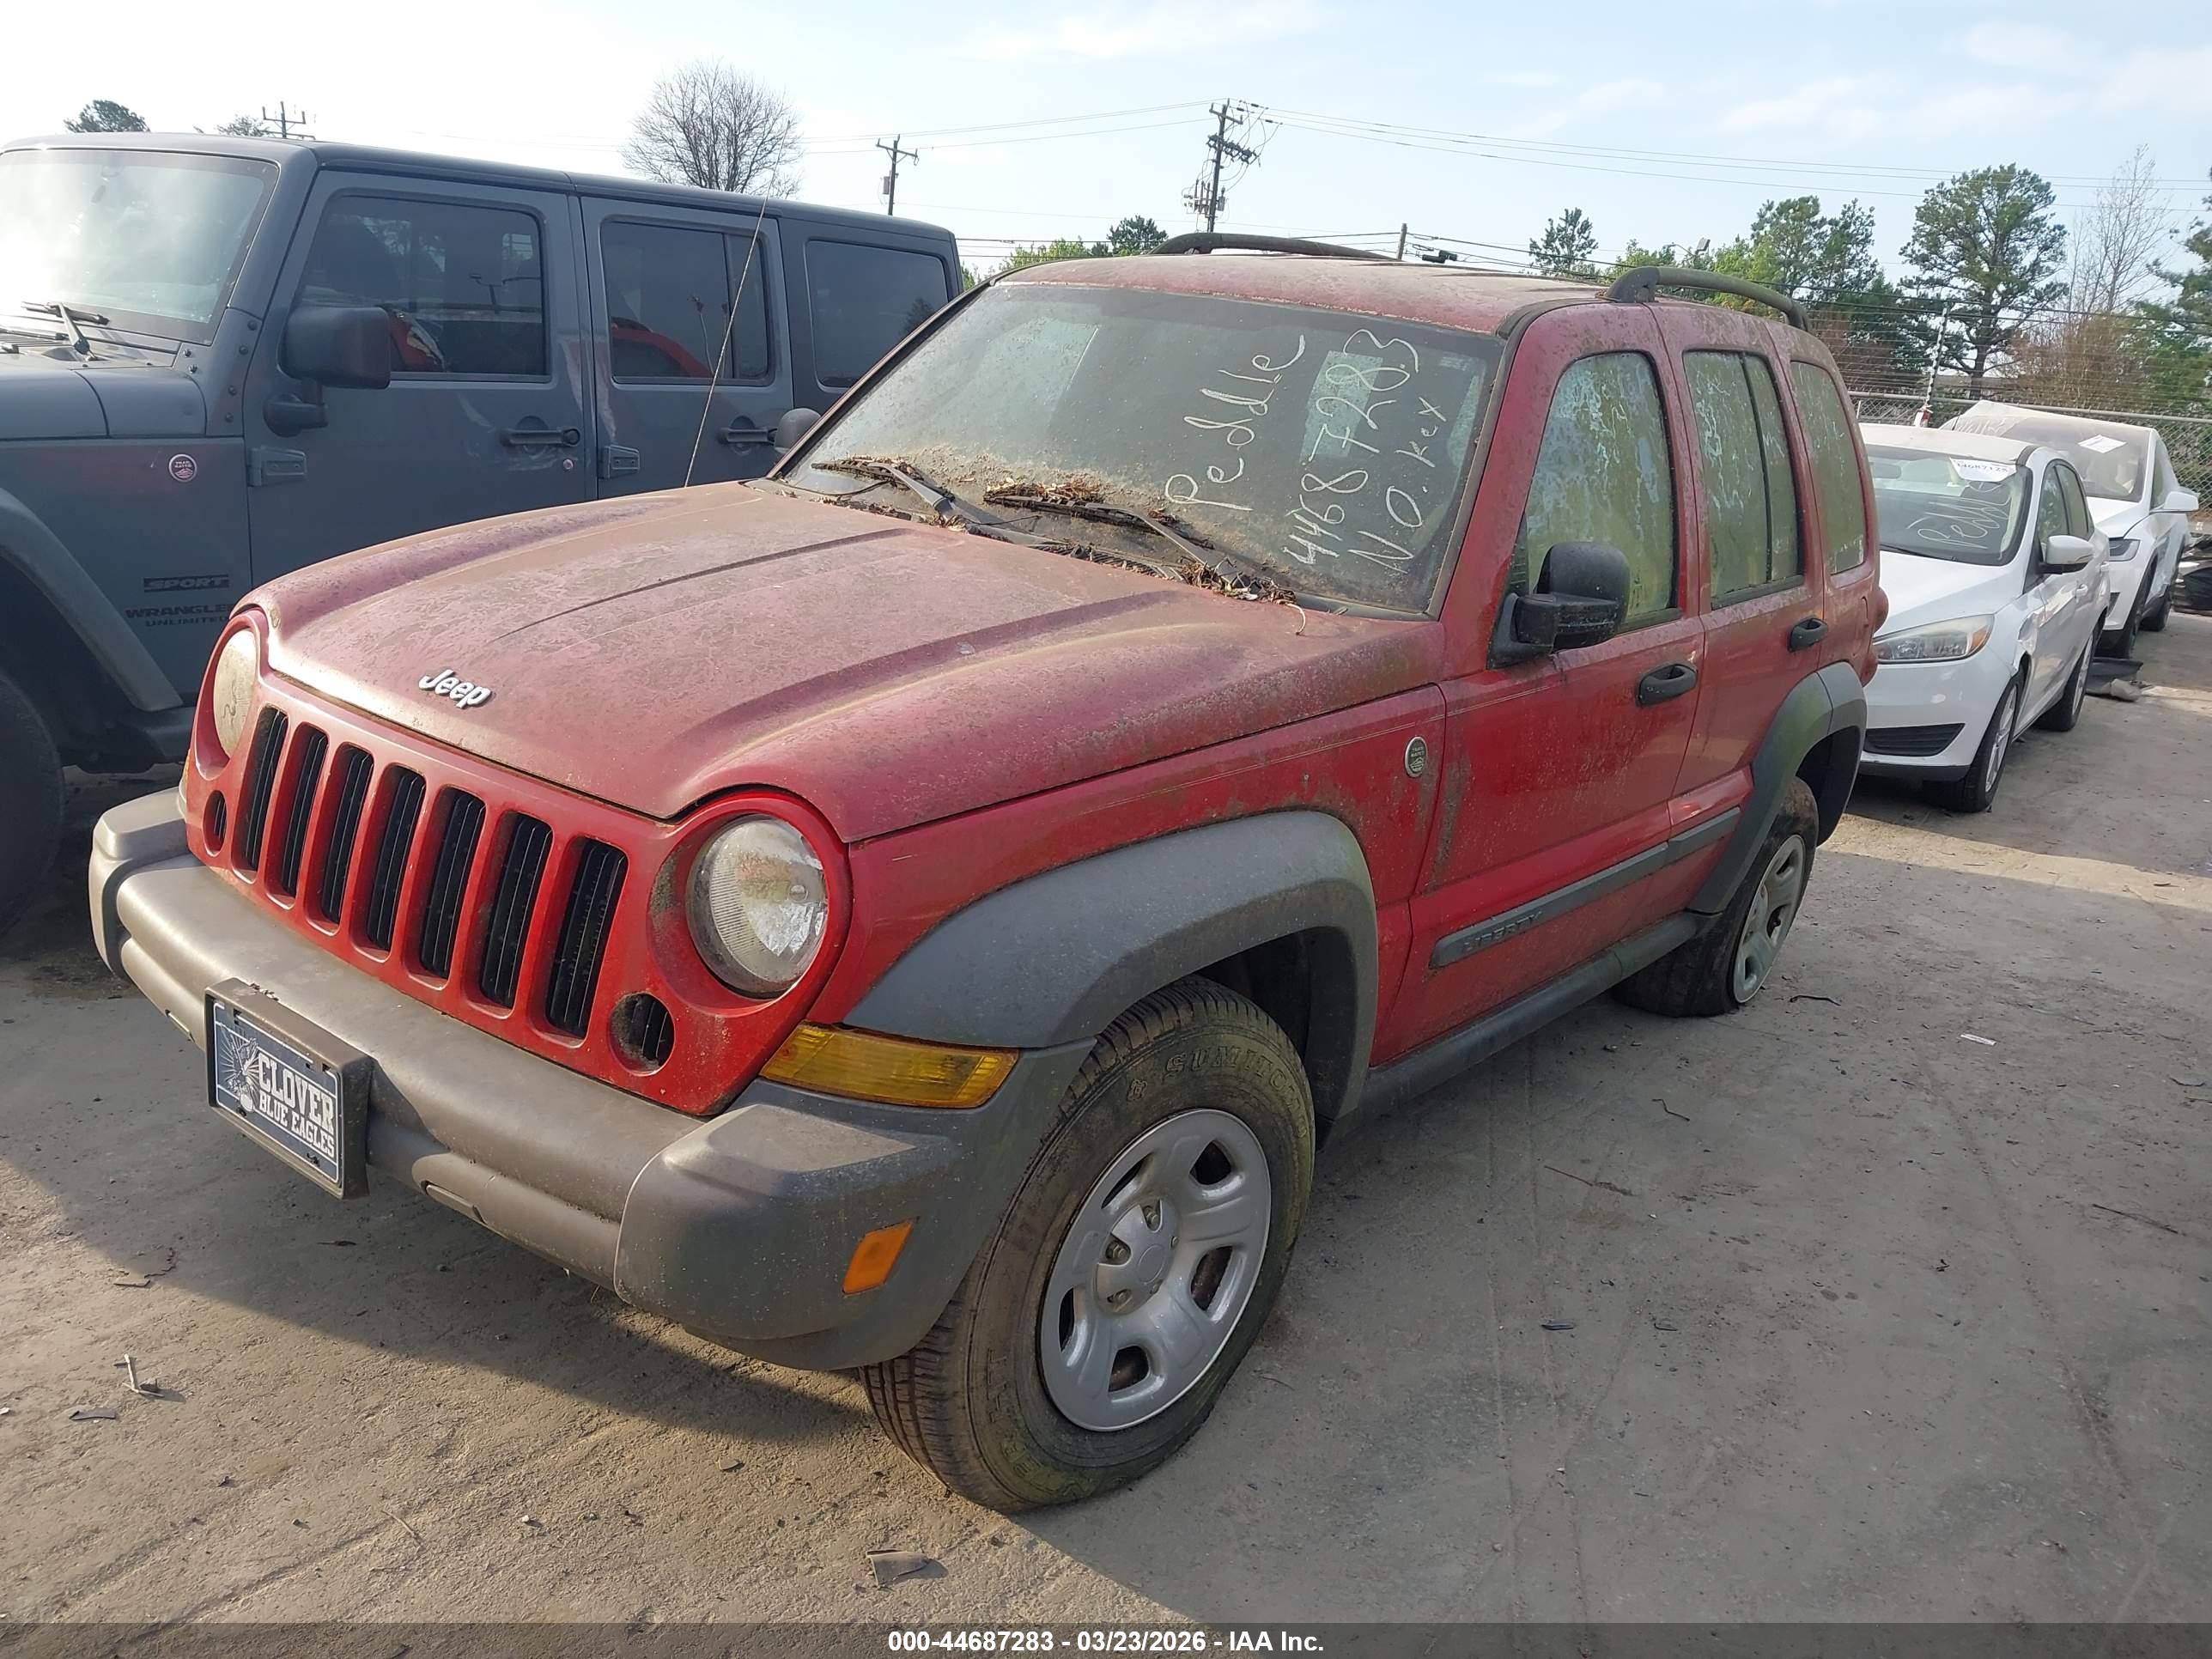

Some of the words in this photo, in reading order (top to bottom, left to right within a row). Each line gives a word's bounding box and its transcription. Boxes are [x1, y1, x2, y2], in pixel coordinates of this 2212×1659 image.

[1164, 333, 1306, 512] Peddle
[1283, 329, 1419, 564] 44687283
[148, 576, 230, 590] SPORT
[418, 669, 492, 708] Jeep
[258, 1053, 335, 1135] CLOVER
[259, 1093, 289, 1127] BLUE
[291, 1114, 335, 1158] EAGLES
